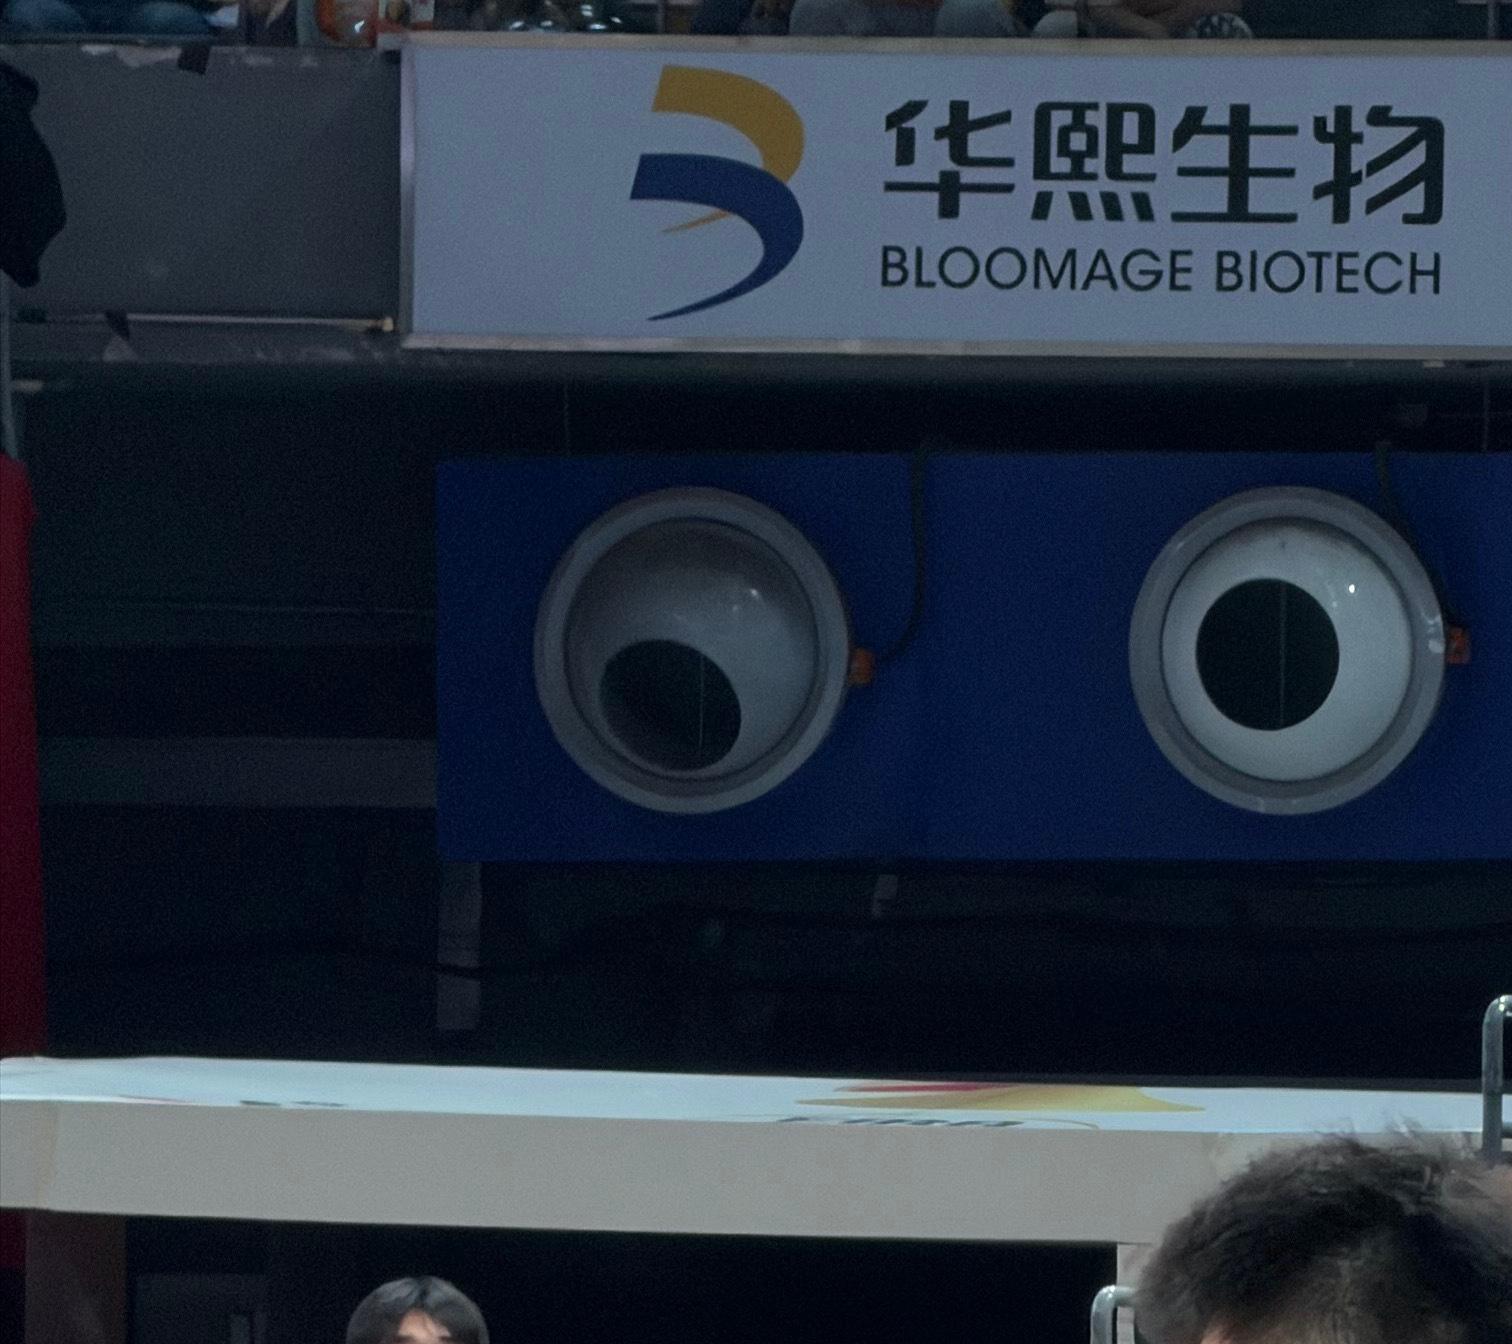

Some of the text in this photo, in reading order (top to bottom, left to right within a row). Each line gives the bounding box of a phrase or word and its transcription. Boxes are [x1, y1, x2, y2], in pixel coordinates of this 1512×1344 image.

[883, 98, 1446, 226] 华熙生物
[880, 245, 1441, 296] BLOOMAGE BIOTECH
